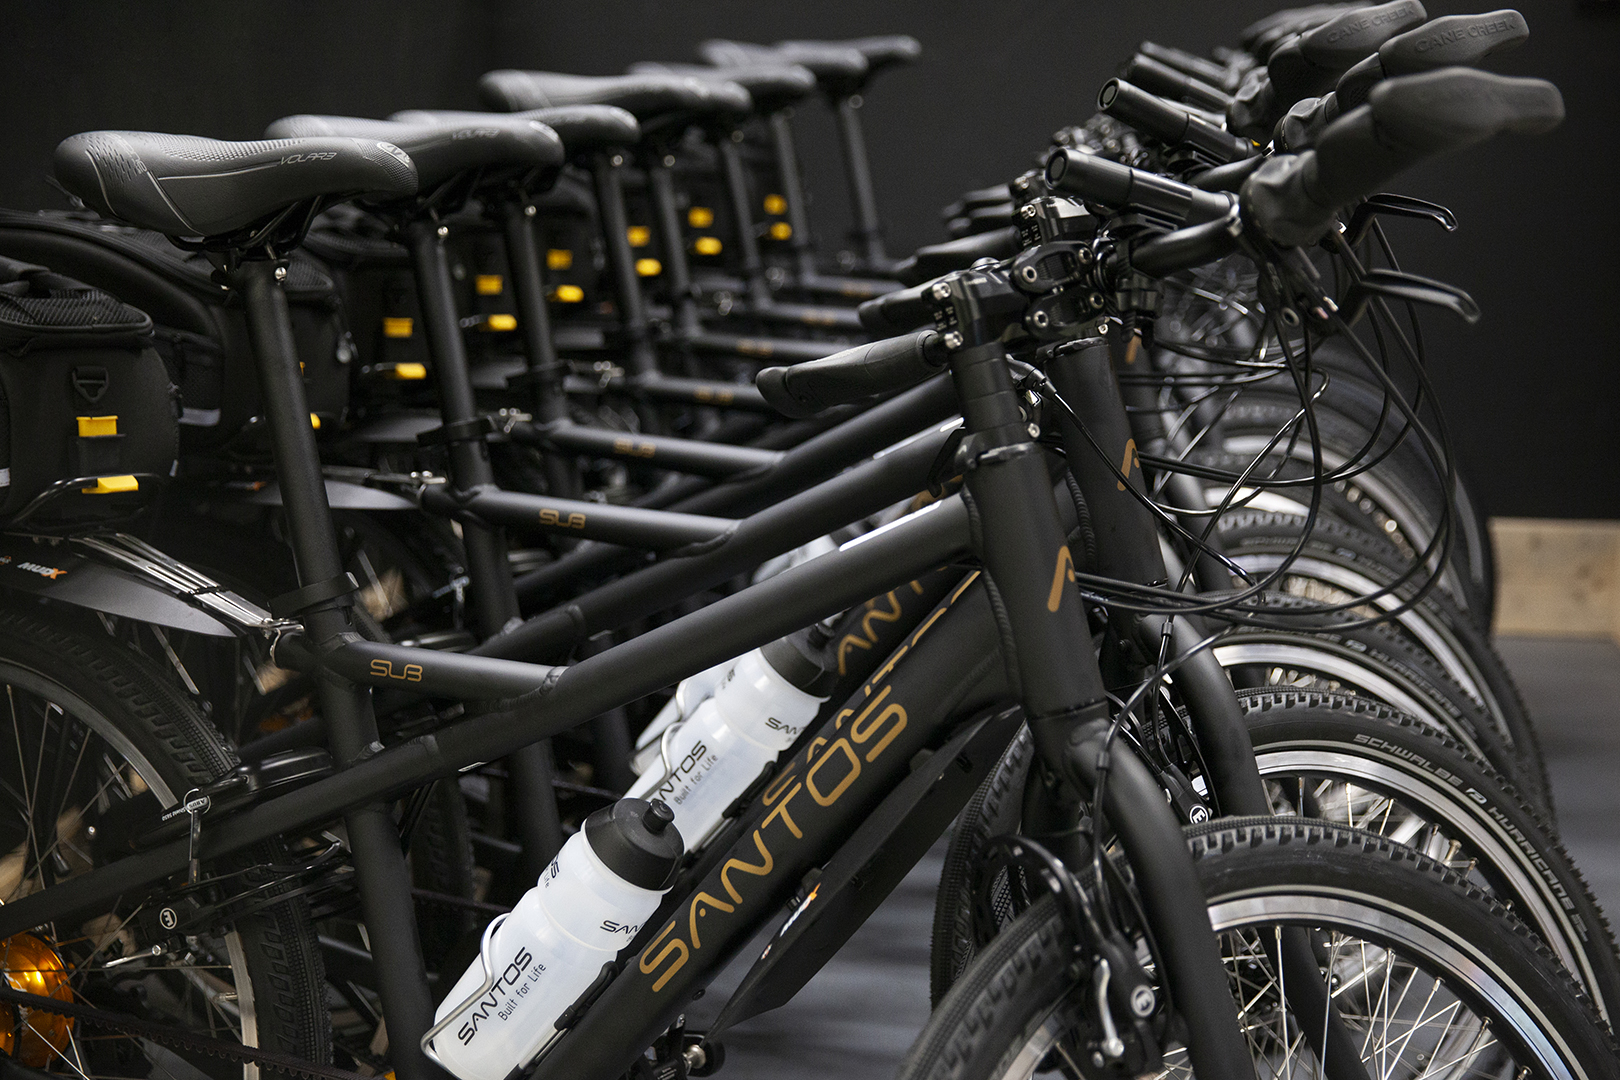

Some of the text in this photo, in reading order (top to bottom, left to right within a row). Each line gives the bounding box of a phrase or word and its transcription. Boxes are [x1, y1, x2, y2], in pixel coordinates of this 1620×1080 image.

[1327, 17, 1370, 44] CANE
[1415, 17, 1517, 52] CANE CREEK
[639, 684, 908, 993] SANTOS
[1352, 733, 1576, 911] SCHWALBE HURRICANE
[457, 946, 533, 1046] SANTOS
[497, 963, 547, 1021] Built for Life
